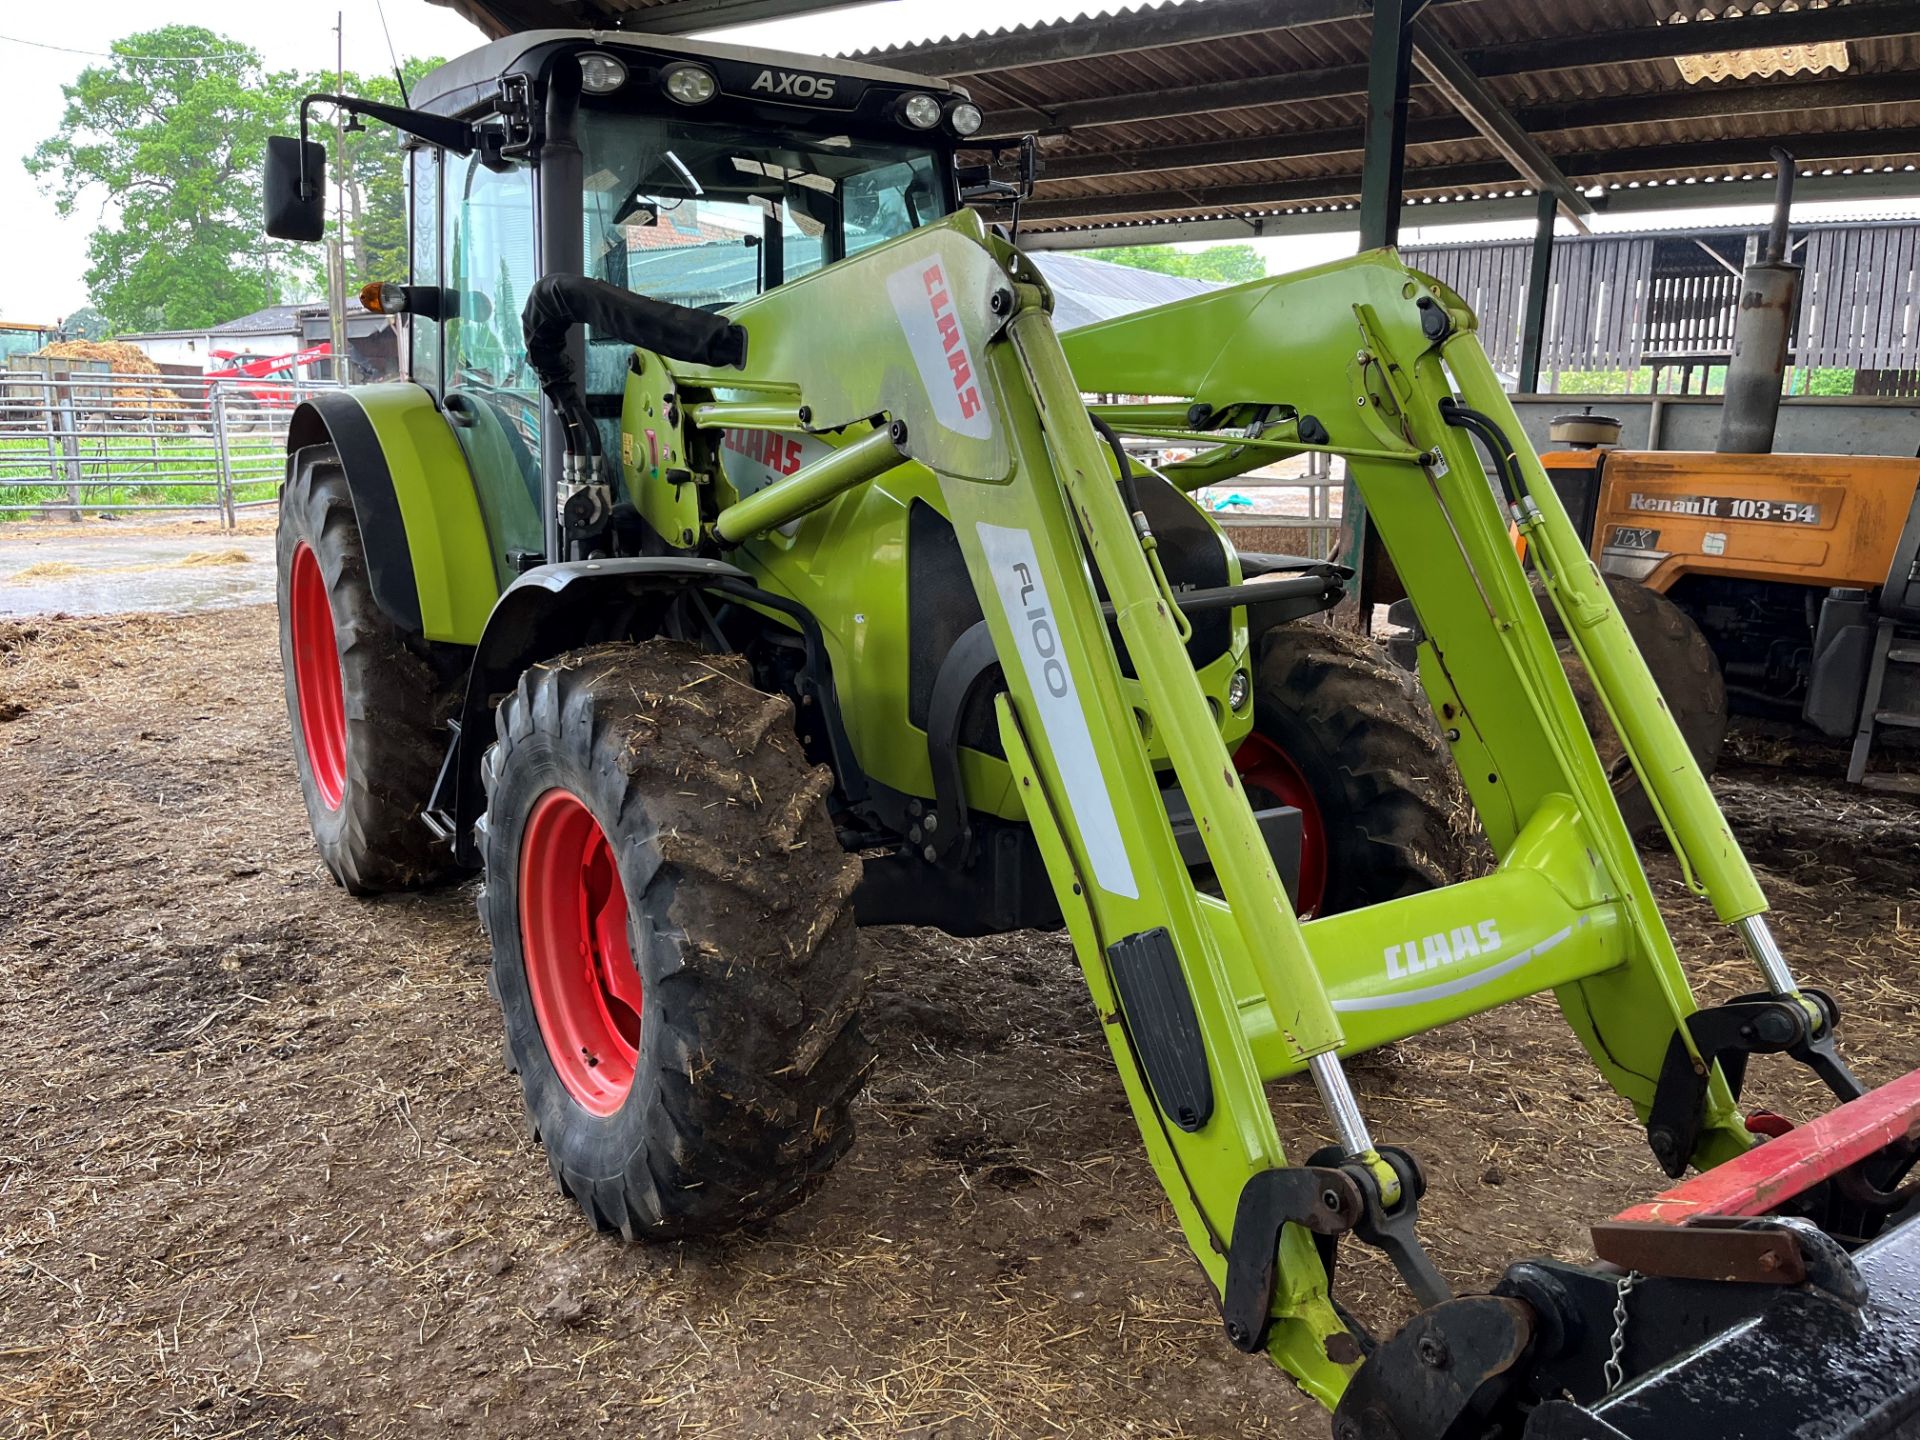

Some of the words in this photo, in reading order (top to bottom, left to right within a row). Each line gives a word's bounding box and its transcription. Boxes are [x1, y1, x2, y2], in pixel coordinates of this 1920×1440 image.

[751, 70, 836, 99] AXOS
[922, 264, 982, 420] CLAAS
[1628, 492, 1719, 517] Renault
[1728, 499, 1816, 523] 103-54
[1614, 526, 1653, 549] TX
[1383, 918, 1502, 981] CLAAS
